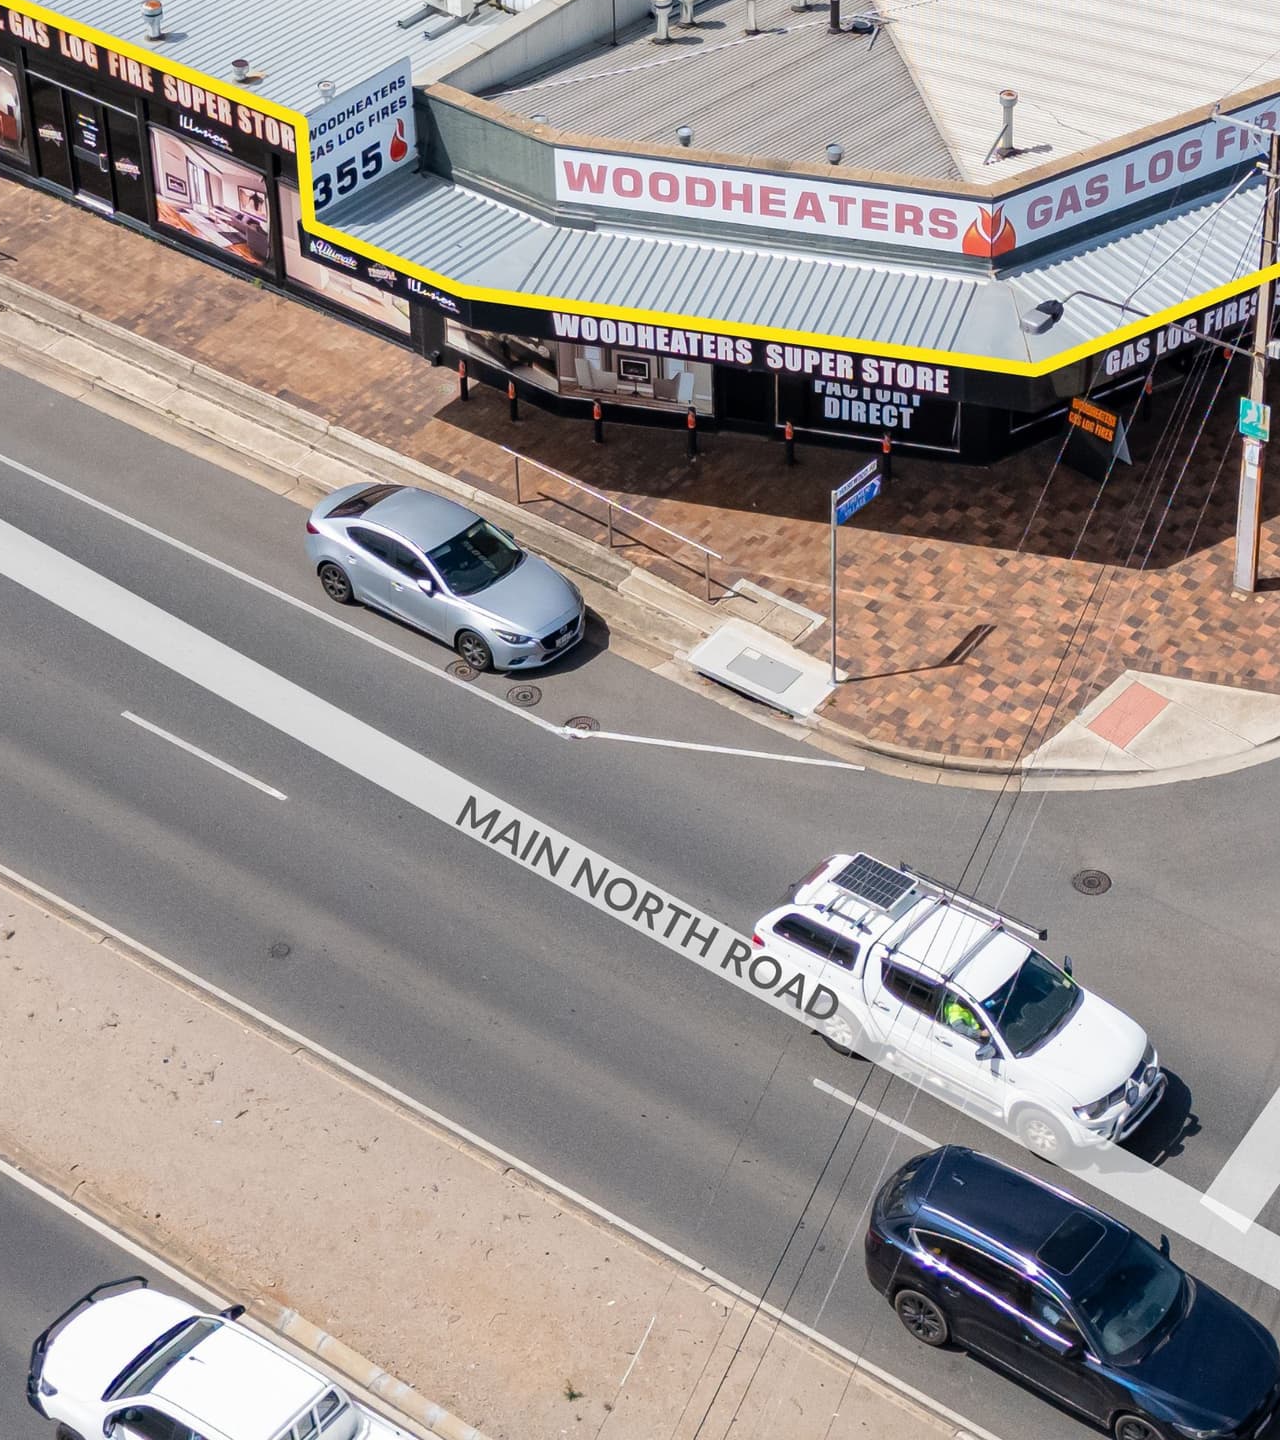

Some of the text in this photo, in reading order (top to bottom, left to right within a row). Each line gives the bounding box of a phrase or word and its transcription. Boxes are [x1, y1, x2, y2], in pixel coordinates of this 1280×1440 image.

[8, 12, 50, 49] GAS
[60, 31, 100, 70] LOG
[107, 49, 155, 93] FIRE
[162, 73, 233, 128] SUPER
[237, 105, 296, 153] STOR
[309, 75, 406, 141] WOODHEATERS
[338, 121, 365, 146] LOG
[368, 96, 408, 127] FIRES
[313, 141, 383, 211] 355
[562, 160, 959, 240] WOODHEATERS
[1026, 174, 1109, 231] GAS
[1124, 138, 1203, 194] LOG
[553, 312, 950, 395] WOODHEATERS SUPER STORE
[1106, 336, 1150, 376] GAS
[1156, 318, 1198, 356] LOG
[824, 396, 914, 429] DIRECT
